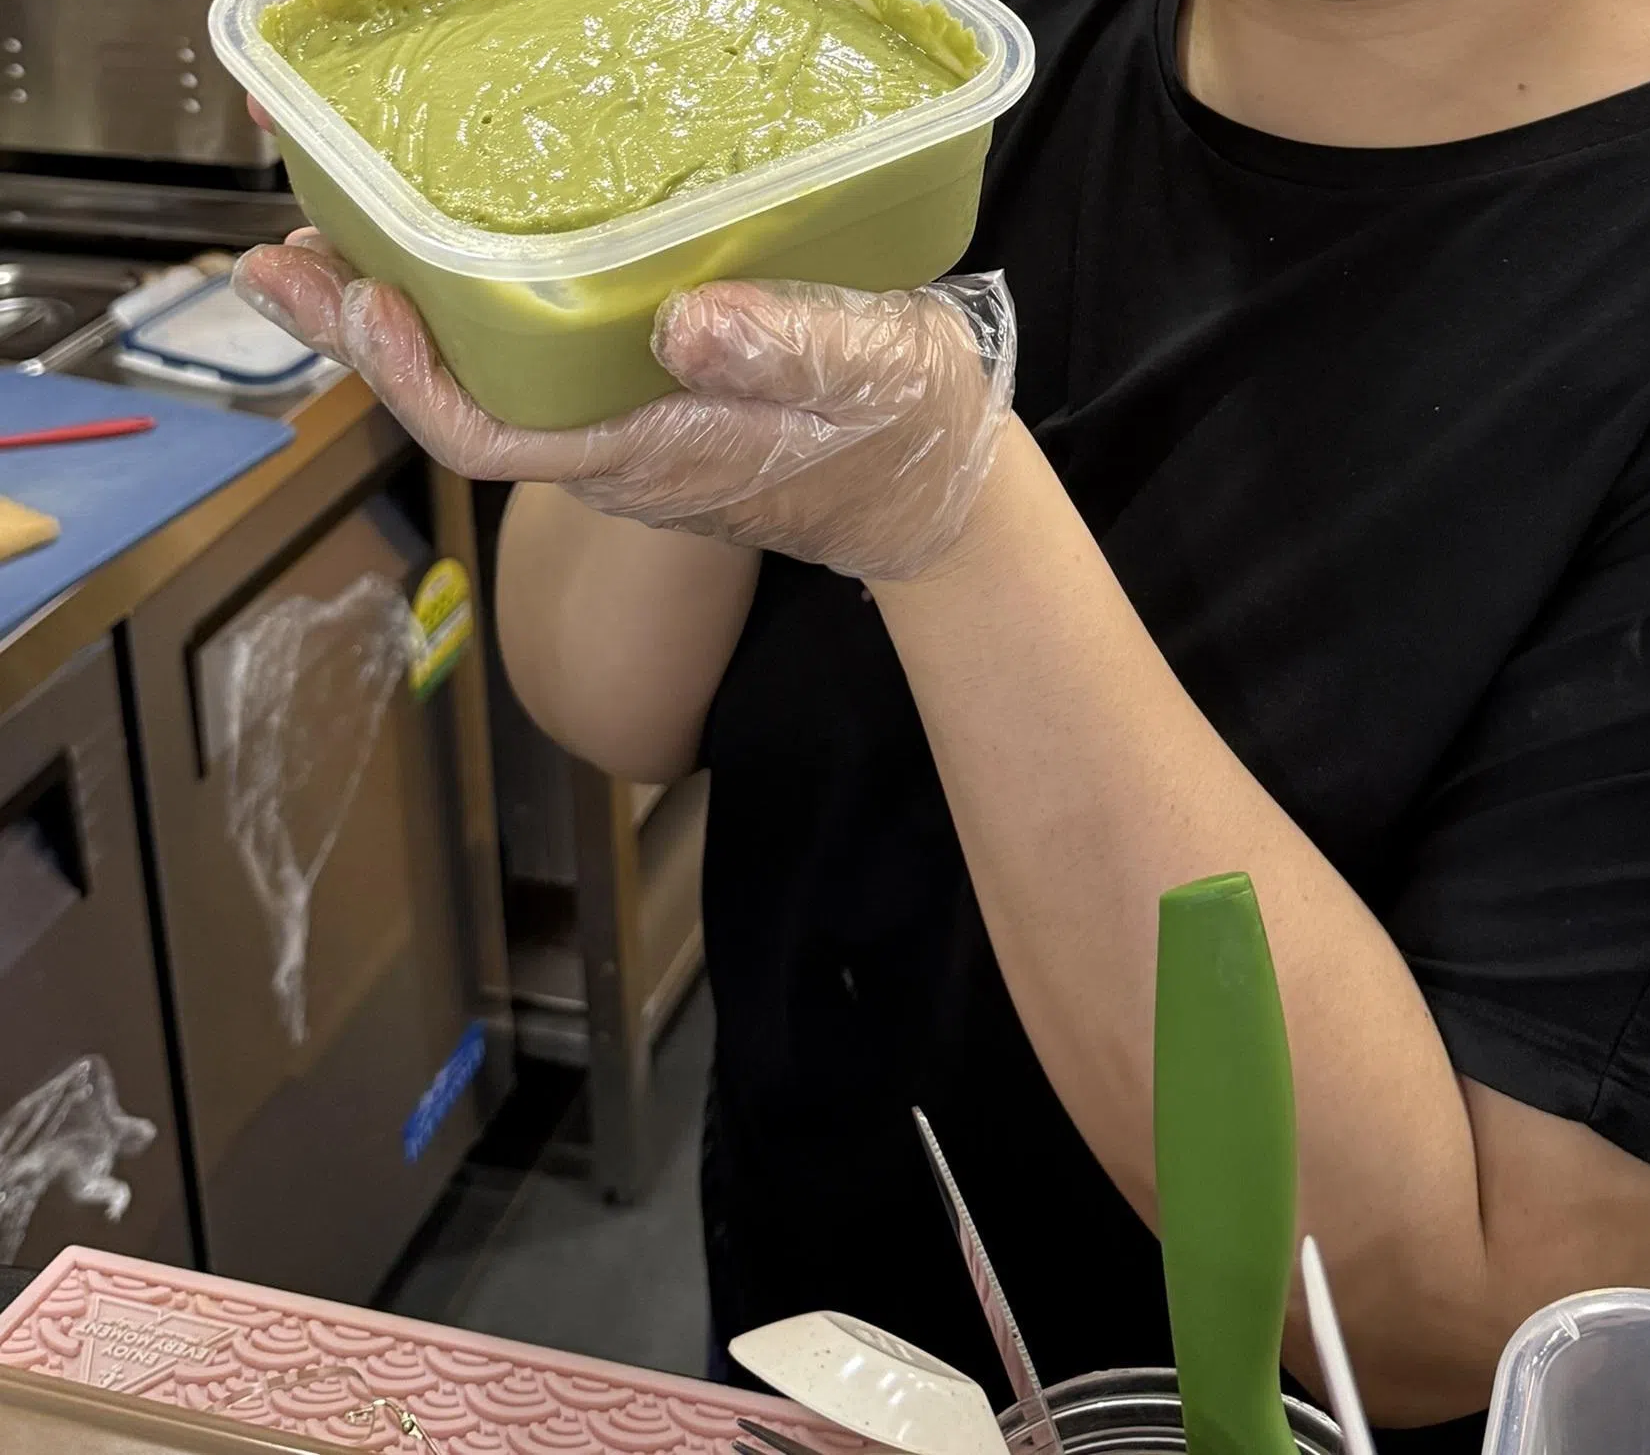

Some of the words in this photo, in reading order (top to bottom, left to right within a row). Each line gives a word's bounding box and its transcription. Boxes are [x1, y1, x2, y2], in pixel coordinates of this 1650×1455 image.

[74, 1321, 158, 1346] MOMENT
[102, 1344, 161, 1368] ENJOY
[156, 1335, 210, 1363] EVERY
